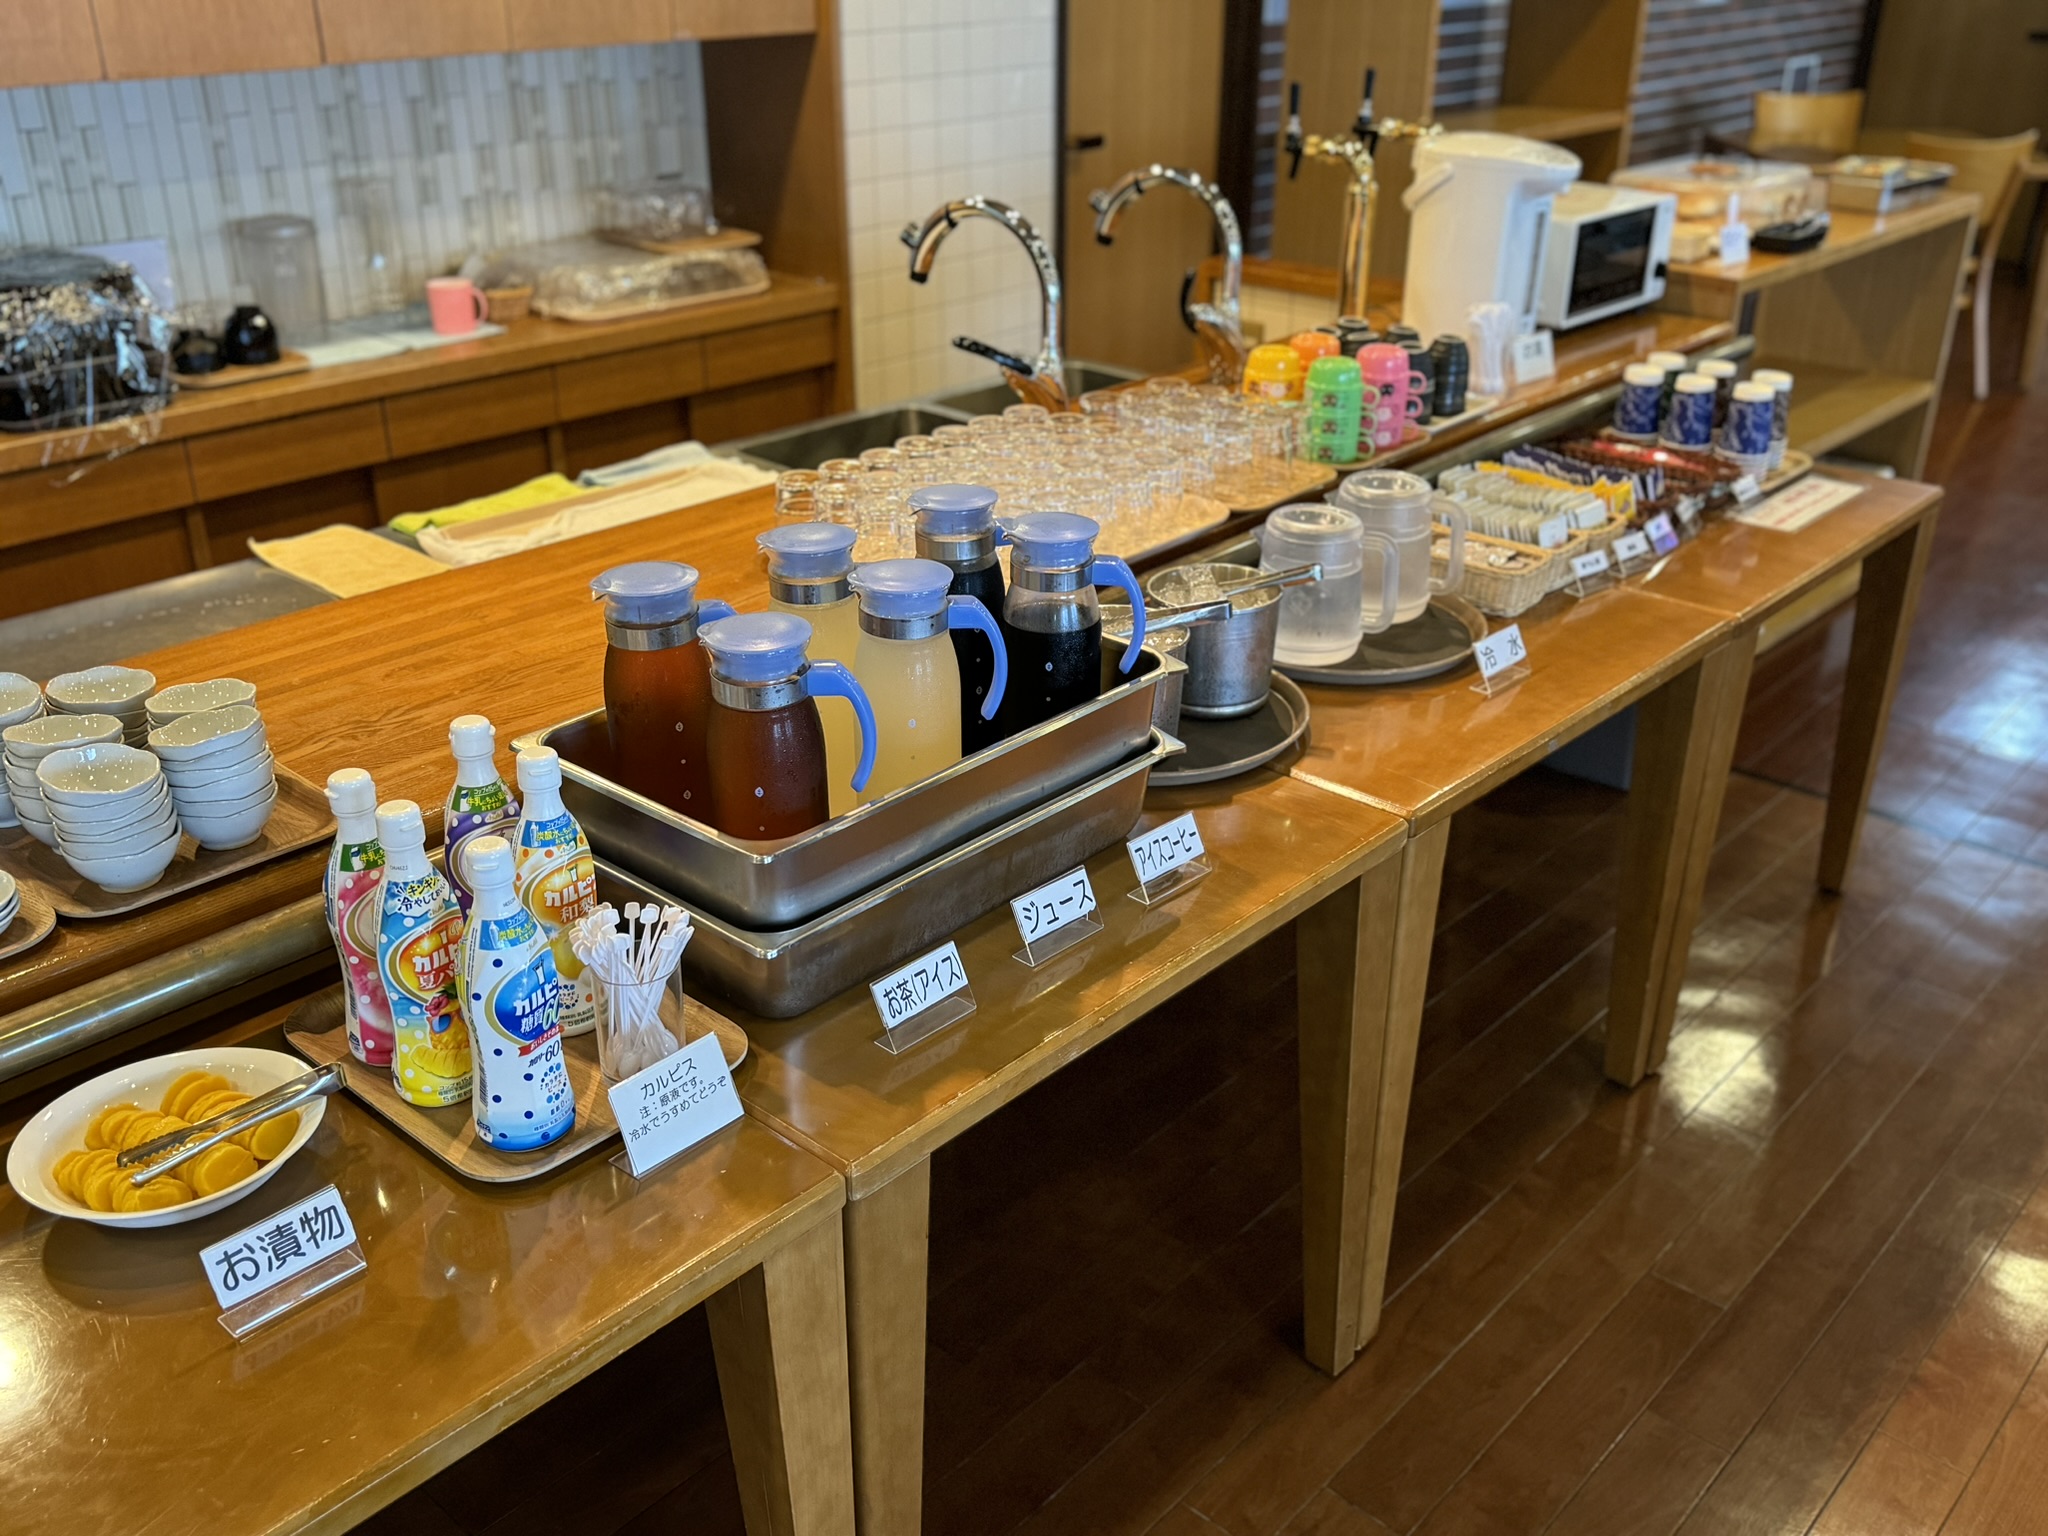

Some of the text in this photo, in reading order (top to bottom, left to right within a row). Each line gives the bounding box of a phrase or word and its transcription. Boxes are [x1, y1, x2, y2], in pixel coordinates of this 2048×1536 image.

[1134, 826, 1197, 876] アイスコーヒー
[1022, 878, 1094, 934] ジュース
[883, 951, 964, 1019] お茶(アイス)
[628, 1075, 727, 1143] 冷水でうすめてどうぞ
[640, 1057, 698, 1101] カルピス
[215, 1204, 345, 1292] お漬物
